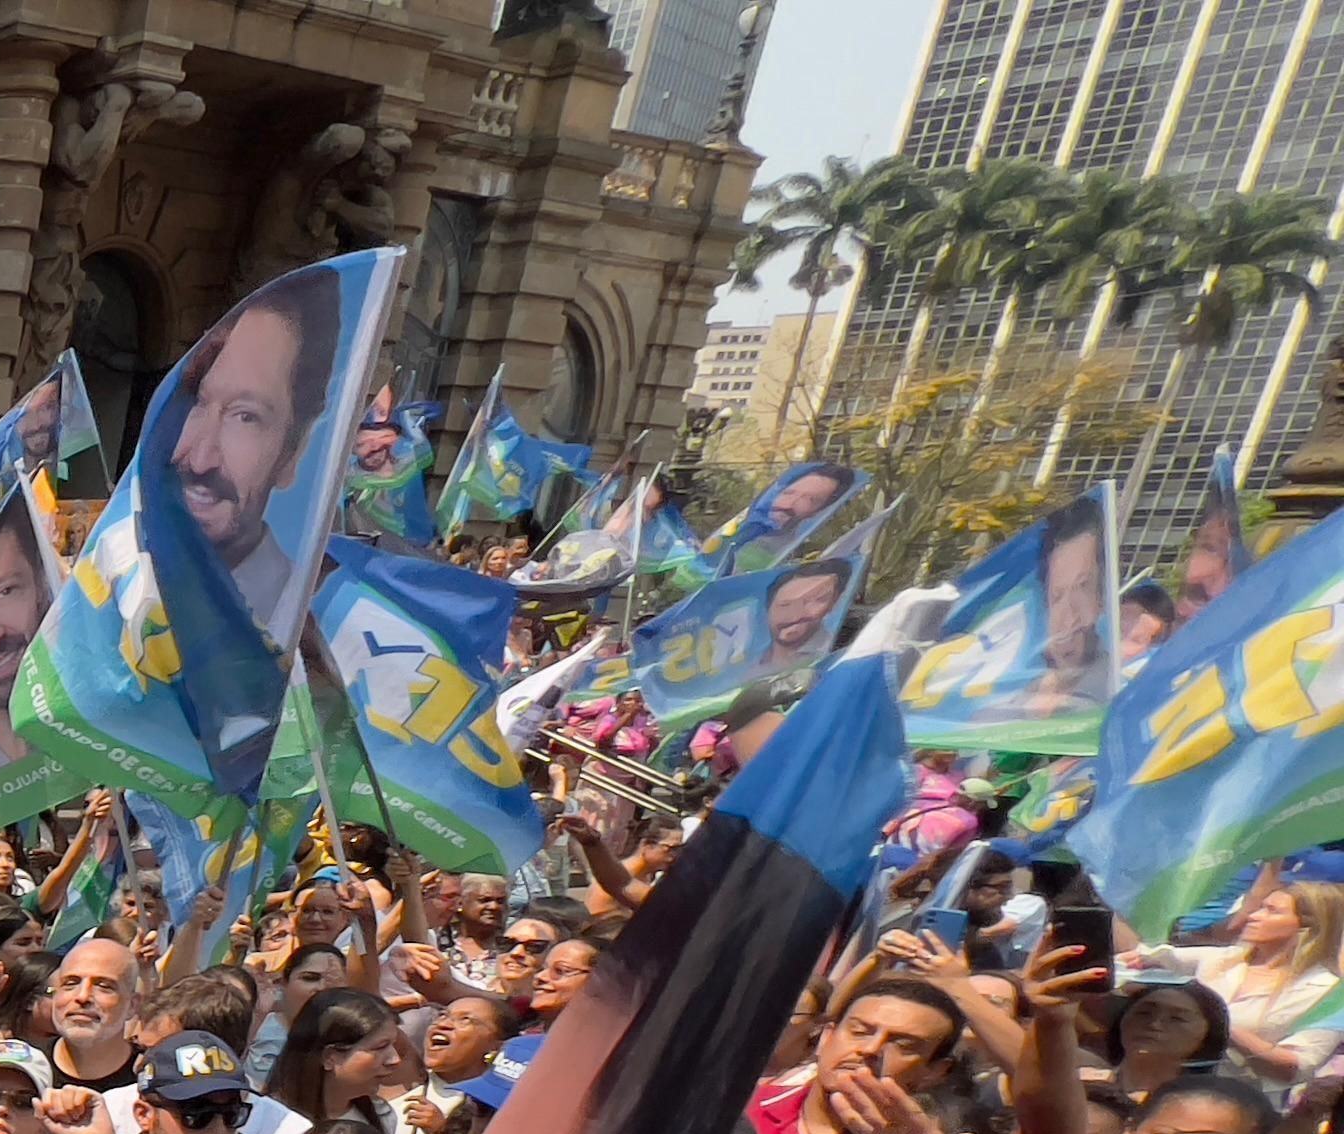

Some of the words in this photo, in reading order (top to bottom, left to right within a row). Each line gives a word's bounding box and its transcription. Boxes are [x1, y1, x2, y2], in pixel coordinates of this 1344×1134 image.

[30, 682, 108, 752] CUIDANDO
[109, 747, 138, 772] DE
[389, 794, 415, 814] DE
[414, 805, 466, 849] GENTE.
[175, 1043, 236, 1078] R15
